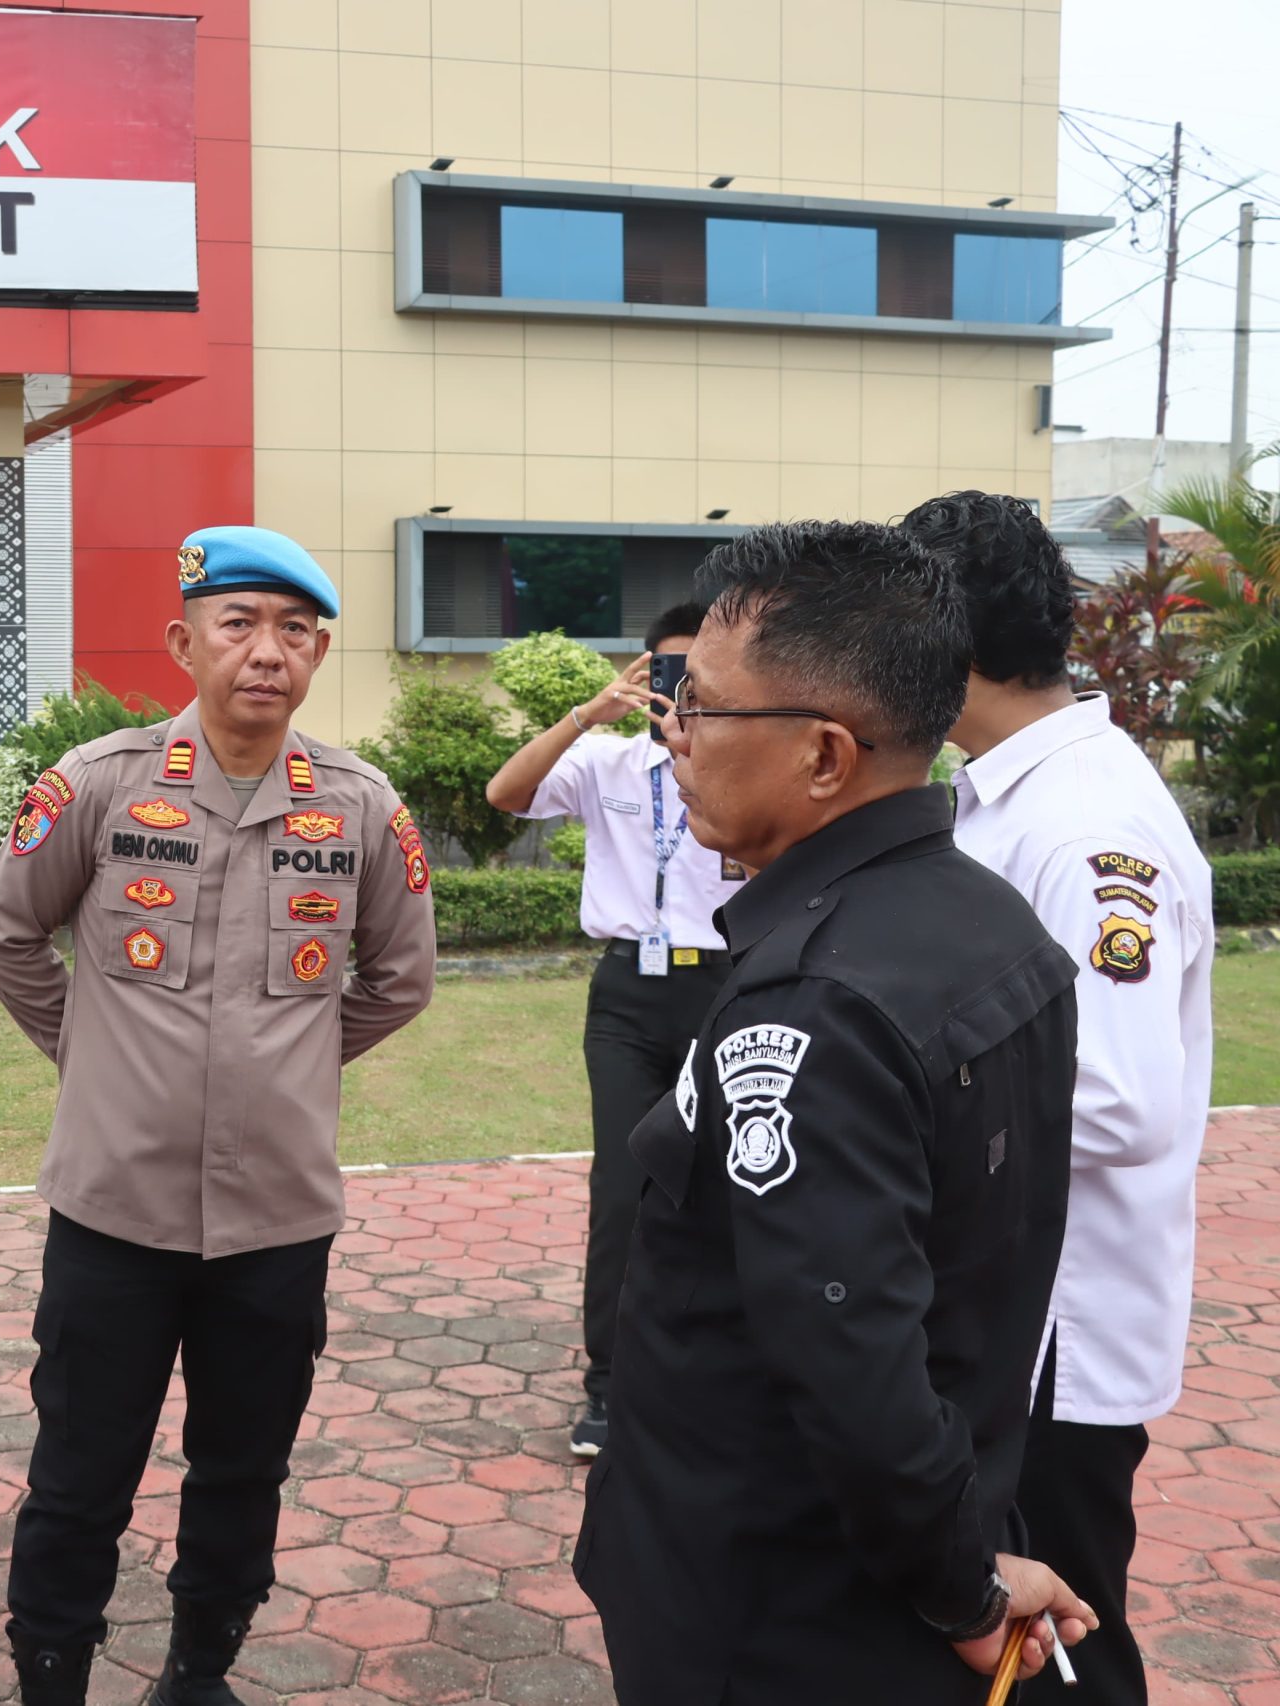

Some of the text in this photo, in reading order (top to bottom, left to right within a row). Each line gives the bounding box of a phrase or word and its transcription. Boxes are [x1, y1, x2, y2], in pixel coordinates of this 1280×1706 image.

[49, 773, 71, 801] PROPAM
[31, 788, 58, 815] PROPAM
[112, 832, 199, 866] BENI OKIMU
[272, 849, 355, 875] POLRI
[1098, 854, 1152, 877] POLRES
[723, 1030, 795, 1061] POLRES
[744, 1047, 795, 1066] BANYUASIN
